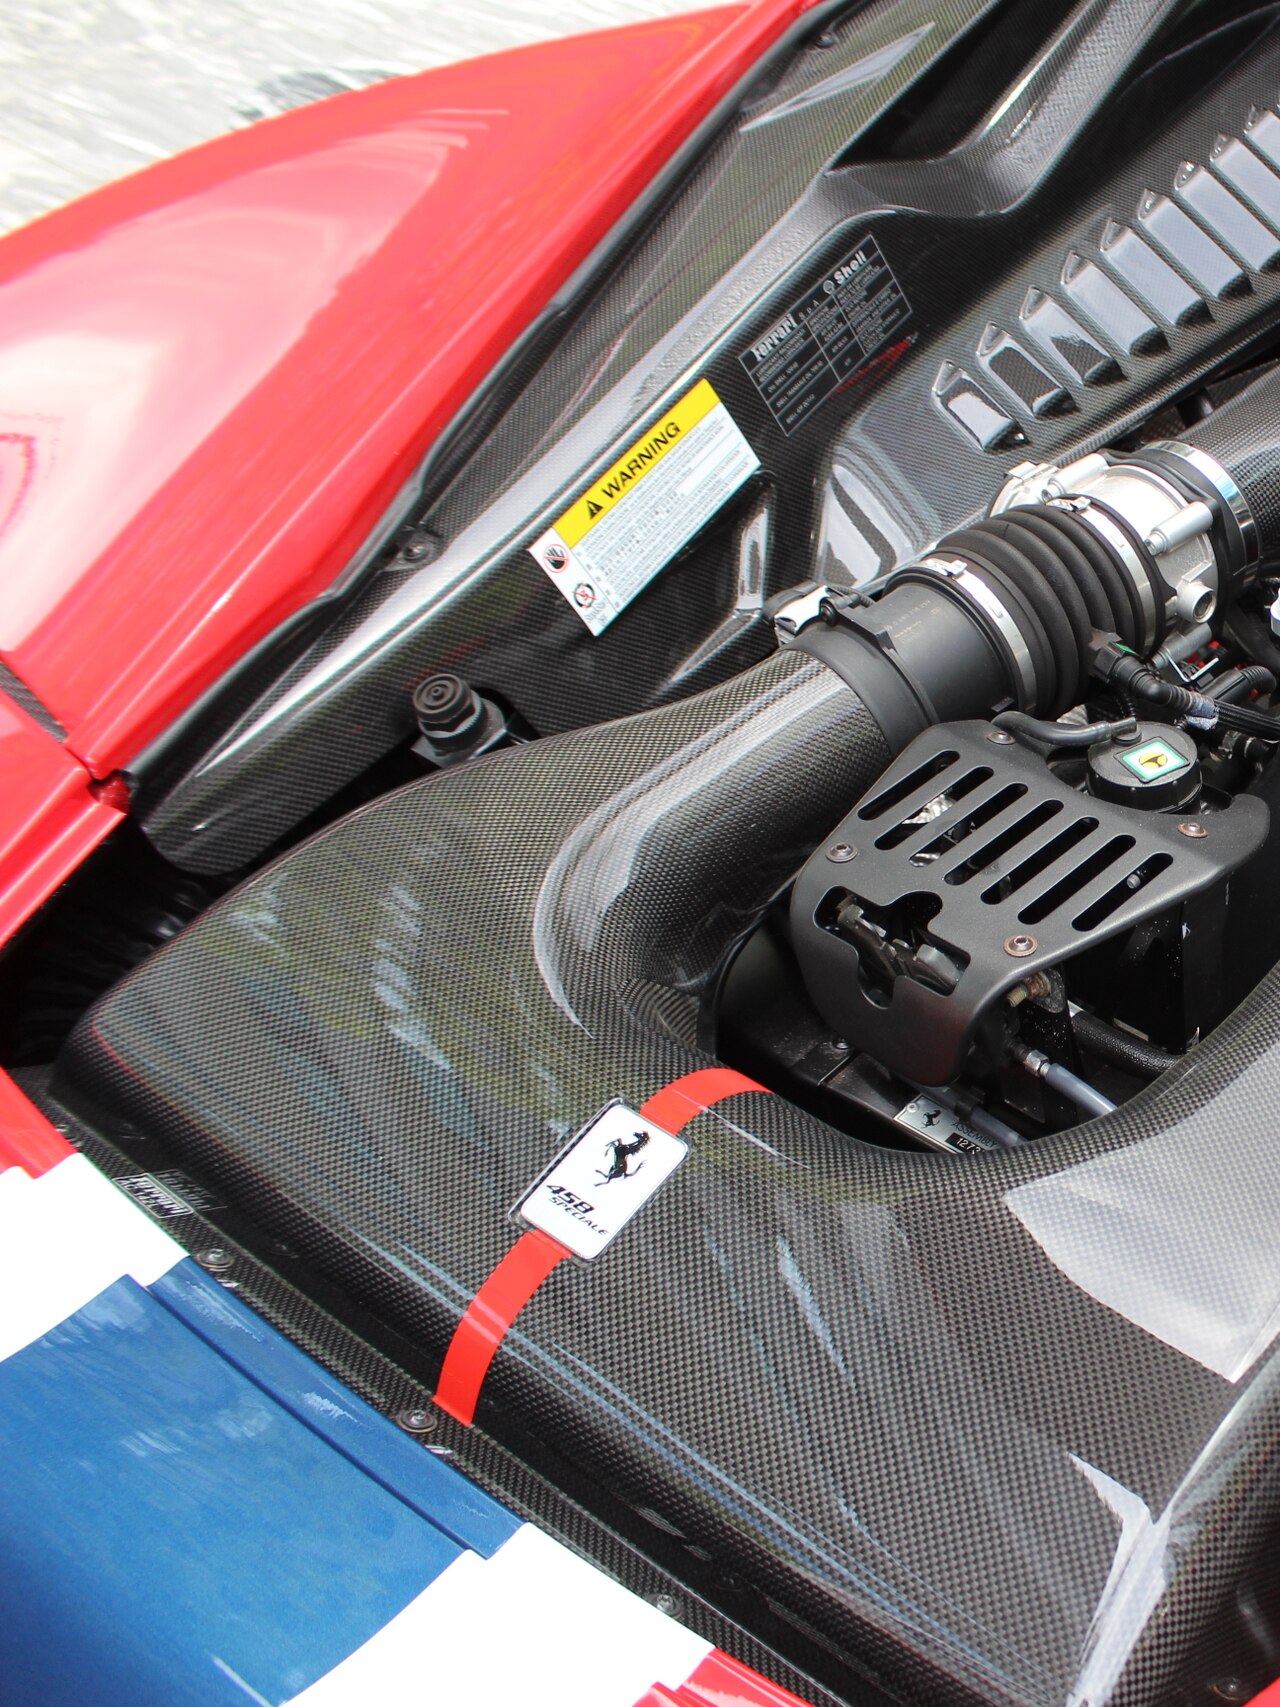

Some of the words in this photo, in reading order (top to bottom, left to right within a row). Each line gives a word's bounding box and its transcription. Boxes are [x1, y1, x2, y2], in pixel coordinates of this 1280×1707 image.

[750, 313, 798, 362] Ferrari
[834, 250, 868, 284] Shell
[602, 421, 681, 499] WARNING
[951, 1121, 998, 1148] ASSEMBLY
[546, 1184, 595, 1214] 458
[548, 1197, 609, 1236] SPECIALE
